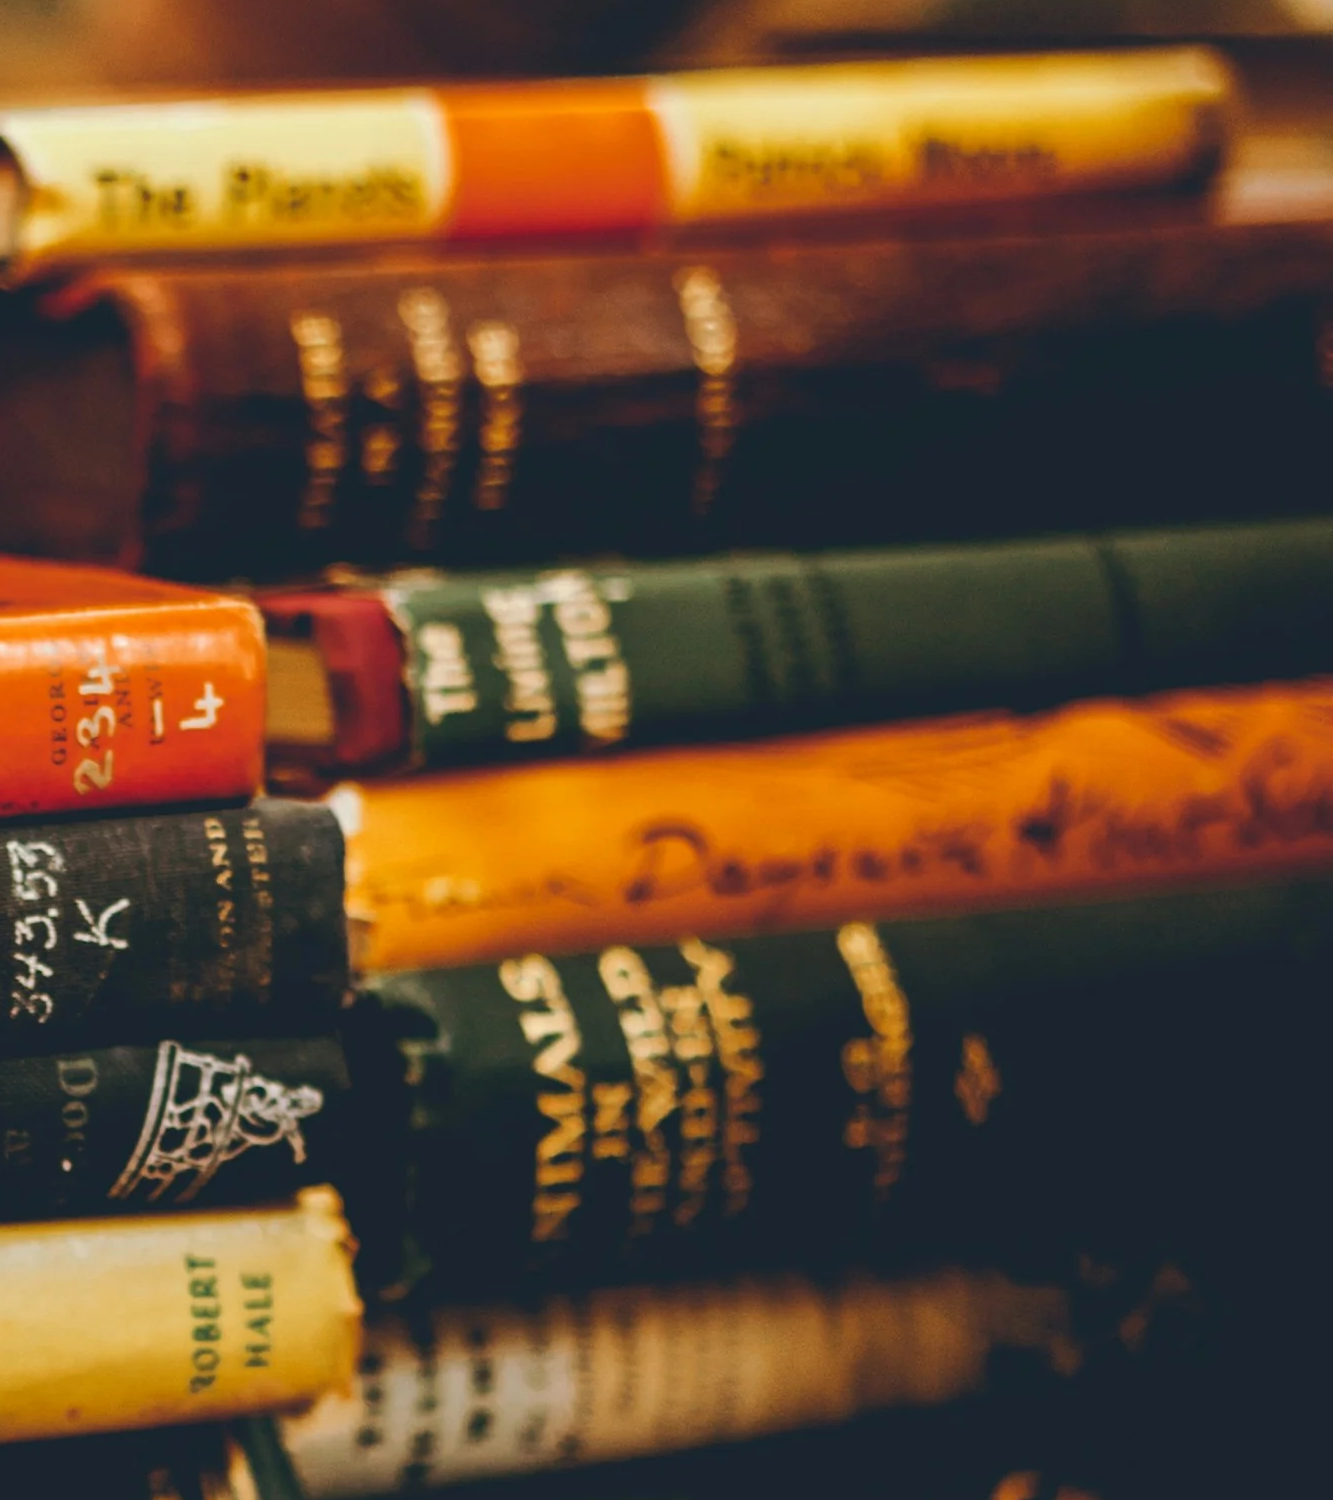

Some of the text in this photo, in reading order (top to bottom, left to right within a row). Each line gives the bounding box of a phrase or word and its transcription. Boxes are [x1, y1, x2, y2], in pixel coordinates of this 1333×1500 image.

[72, 897, 131, 951] K
[189, 1253, 220, 1394] ROBERT
[240, 1271, 274, 1370] HALE
